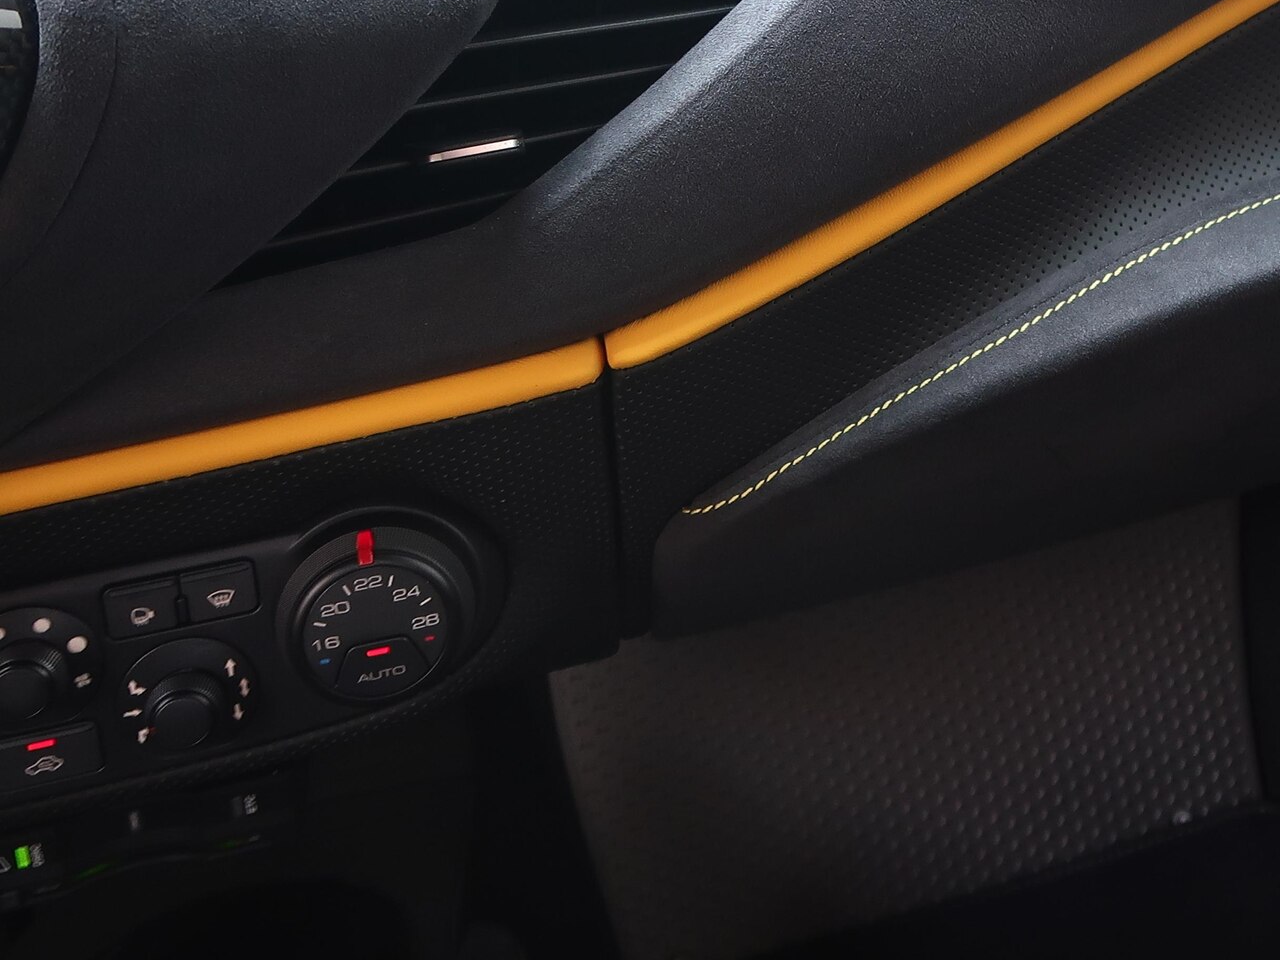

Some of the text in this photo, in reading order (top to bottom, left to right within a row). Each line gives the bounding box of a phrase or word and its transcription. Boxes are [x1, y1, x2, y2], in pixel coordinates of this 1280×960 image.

[320, 601, 350, 617] 20
[354, 575, 383, 591] 22
[392, 585, 421, 601] 24
[411, 613, 440, 629] 28
[357, 665, 406, 683] AUTO
